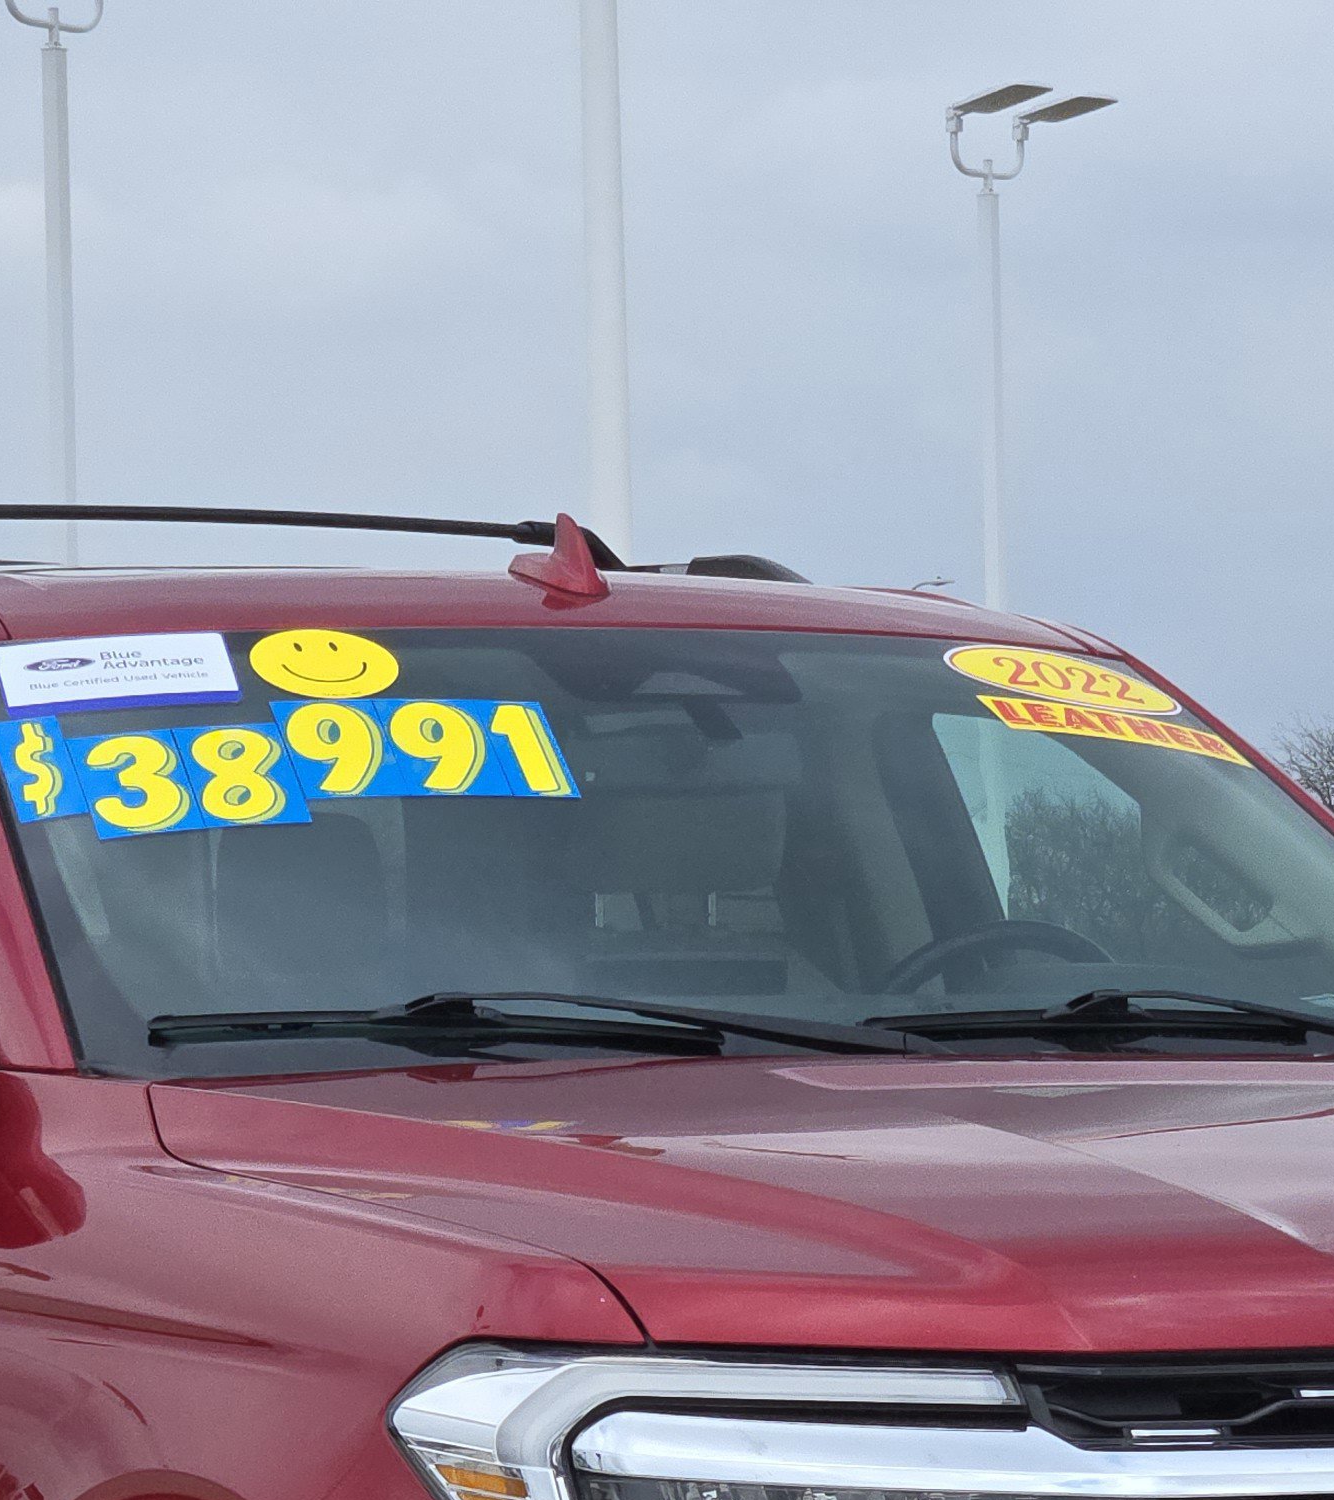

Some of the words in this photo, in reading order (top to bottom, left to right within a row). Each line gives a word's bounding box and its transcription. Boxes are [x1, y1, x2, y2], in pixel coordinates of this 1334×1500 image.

[99, 649, 143, 660] Blue
[102, 656, 205, 671] Advantage
[29, 681, 59, 691] Blue
[63, 675, 120, 687] Certified
[123, 673, 158, 682] Used
[161, 670, 209, 680] Vehicle
[992, 655, 1145, 705] 2022
[991, 699, 1240, 760] LEATHER
